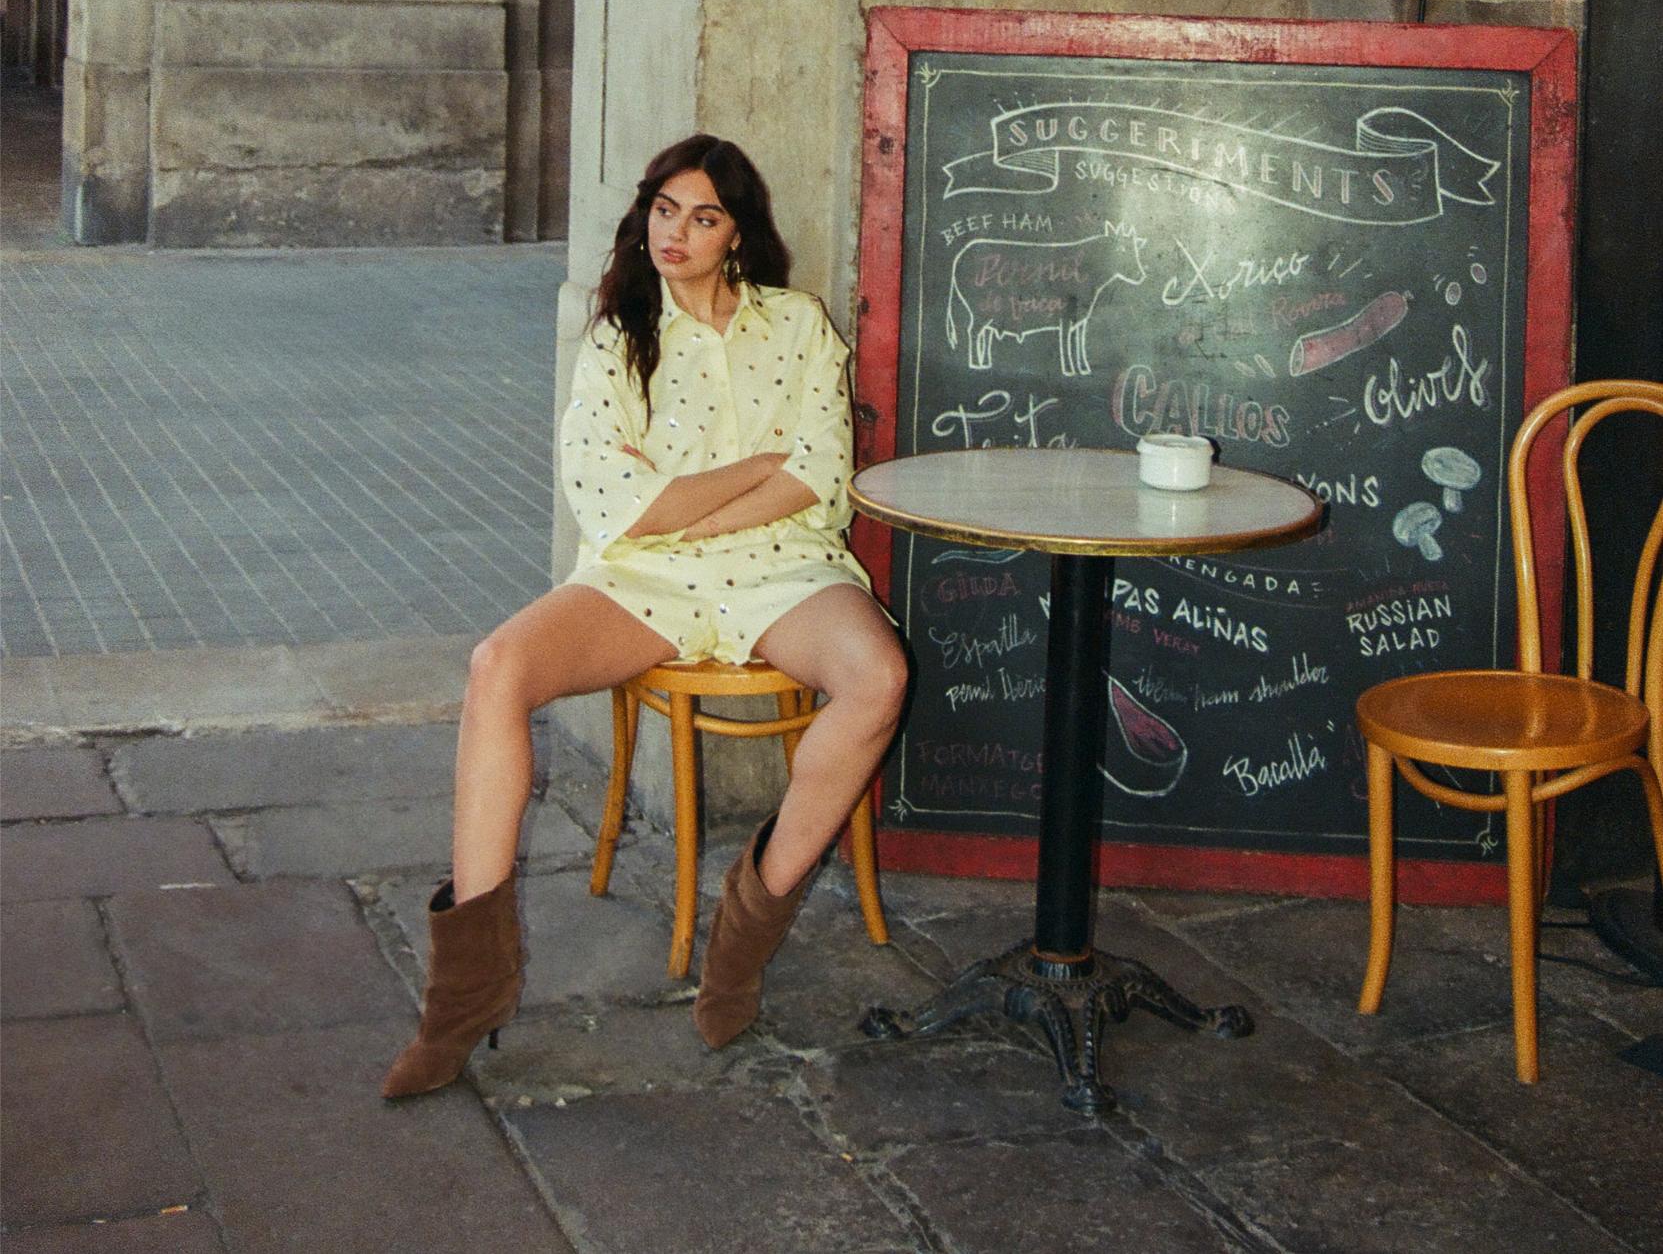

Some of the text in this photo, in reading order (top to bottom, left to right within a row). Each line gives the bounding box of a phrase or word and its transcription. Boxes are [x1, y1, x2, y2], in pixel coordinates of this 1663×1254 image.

[1008, 116, 1396, 207] SUGGERIMENTS
[1074, 159, 1237, 215] SUGGESTIONS
[940, 212, 1054, 246] BEEF HAM
[1162, 235, 1310, 306] Xoriço
[1113, 364, 1290, 447] CALLOS
[1104, 578, 1161, 615] PAS
[1360, 627, 1440, 657] SALAD
